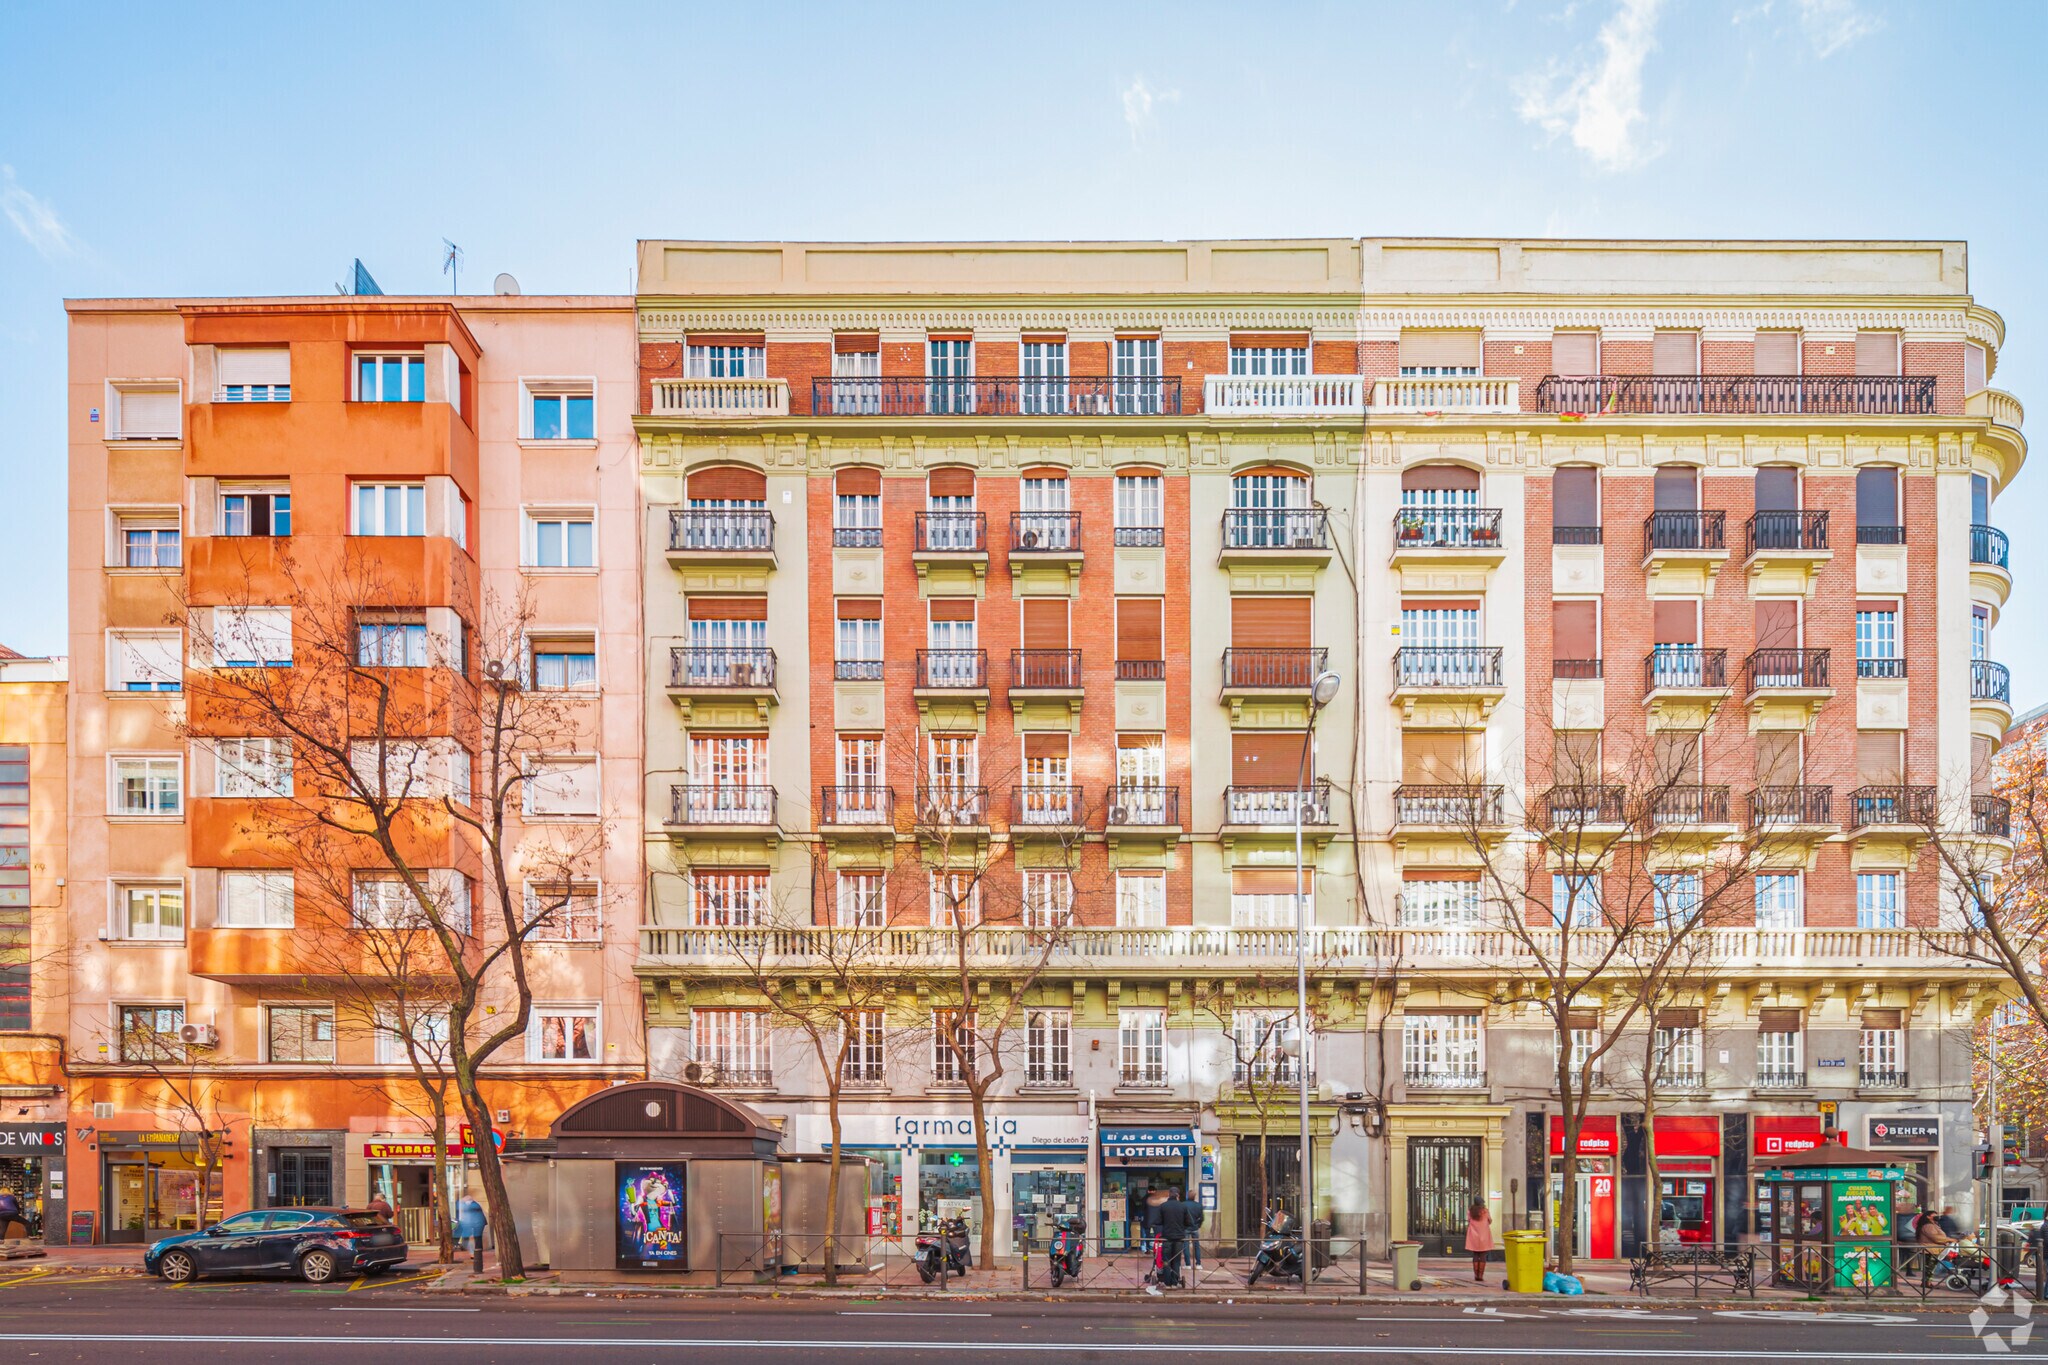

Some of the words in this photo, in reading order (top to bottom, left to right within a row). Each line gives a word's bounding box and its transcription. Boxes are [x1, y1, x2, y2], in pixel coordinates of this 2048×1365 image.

[1889, 1127, 1926, 1135] BEHER
[1032, 1136, 1052, 1145] Diego
[387, 1145, 450, 1154] TABAC
[1116, 1145, 1182, 1156] LOTERÍA
[1595, 1178, 1611, 1193] 20
[643, 1230, 682, 1243] ¡CANTA!
[660, 1240, 668, 1249] 2
